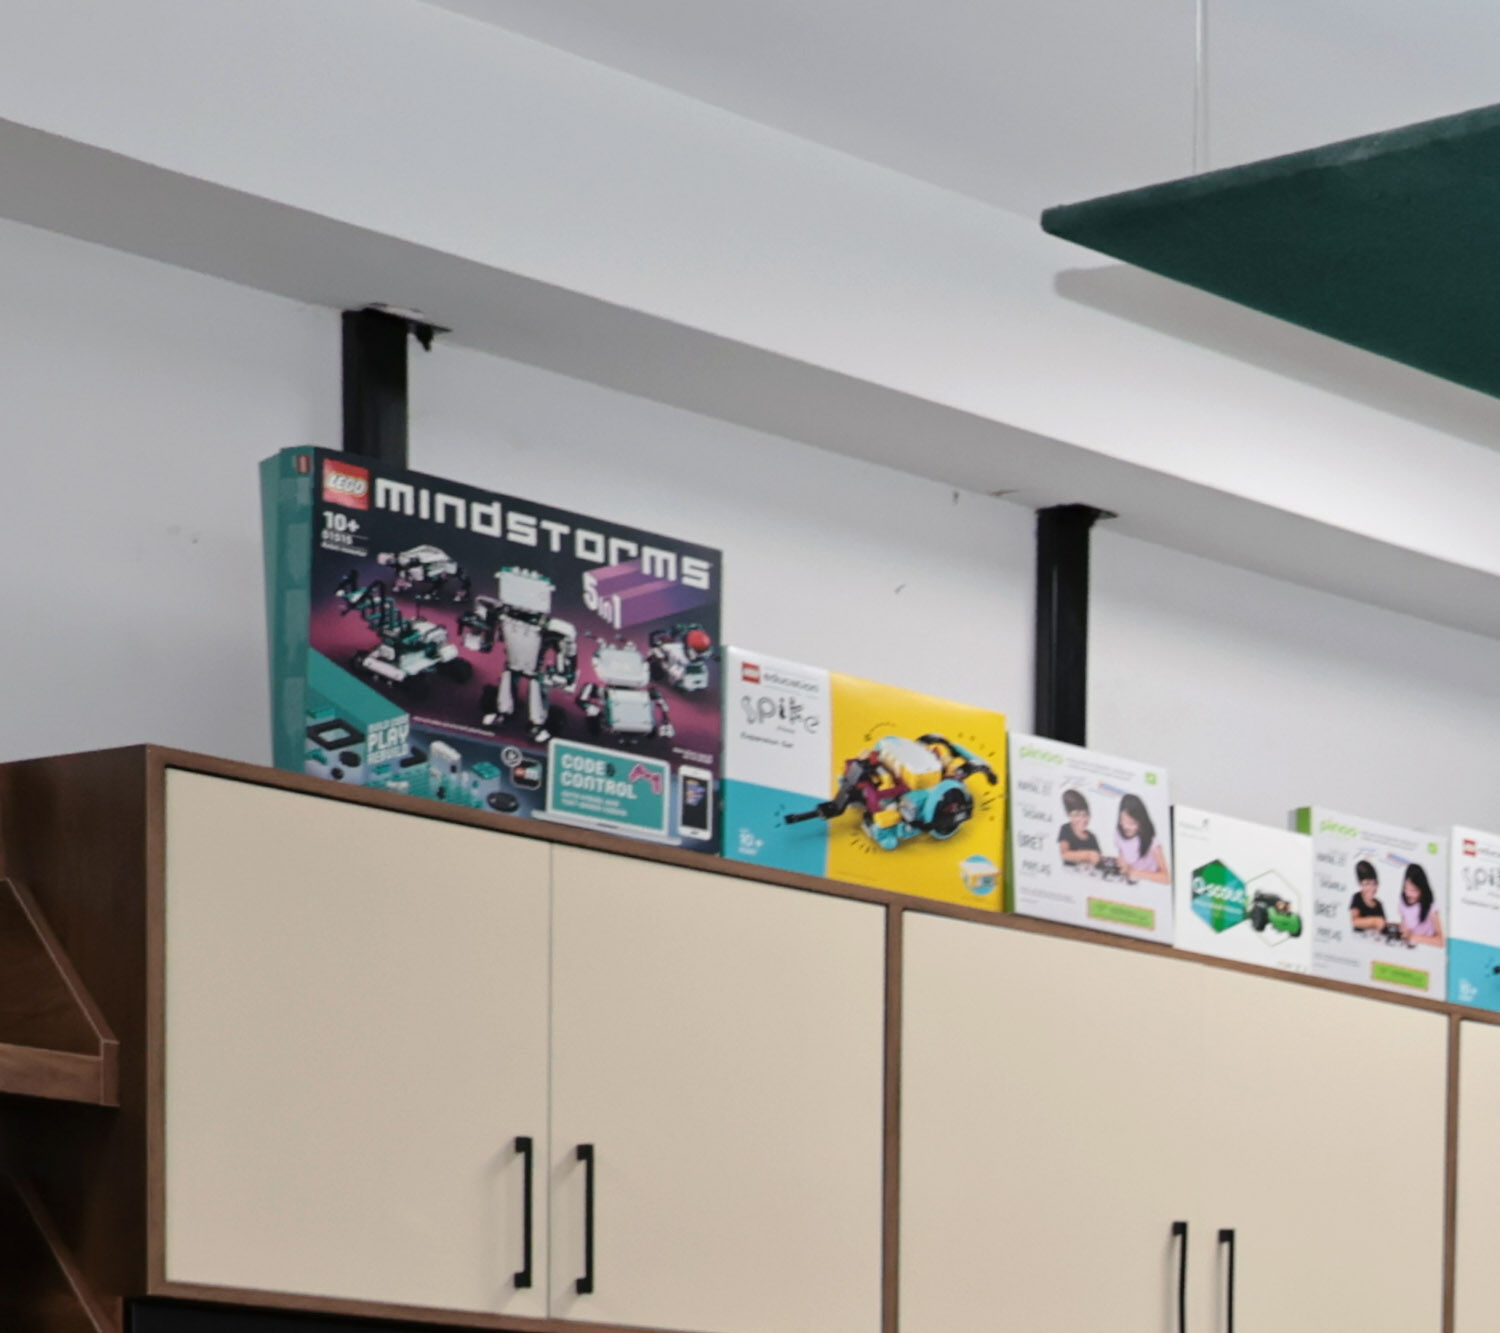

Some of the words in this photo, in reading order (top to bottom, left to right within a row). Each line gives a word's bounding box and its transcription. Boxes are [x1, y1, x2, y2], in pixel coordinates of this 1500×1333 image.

[322, 510, 360, 533] 10+
[368, 724, 410, 754] PLAY
[560, 753, 606, 777] CODE
[560, 770, 638, 801] CONTROL
